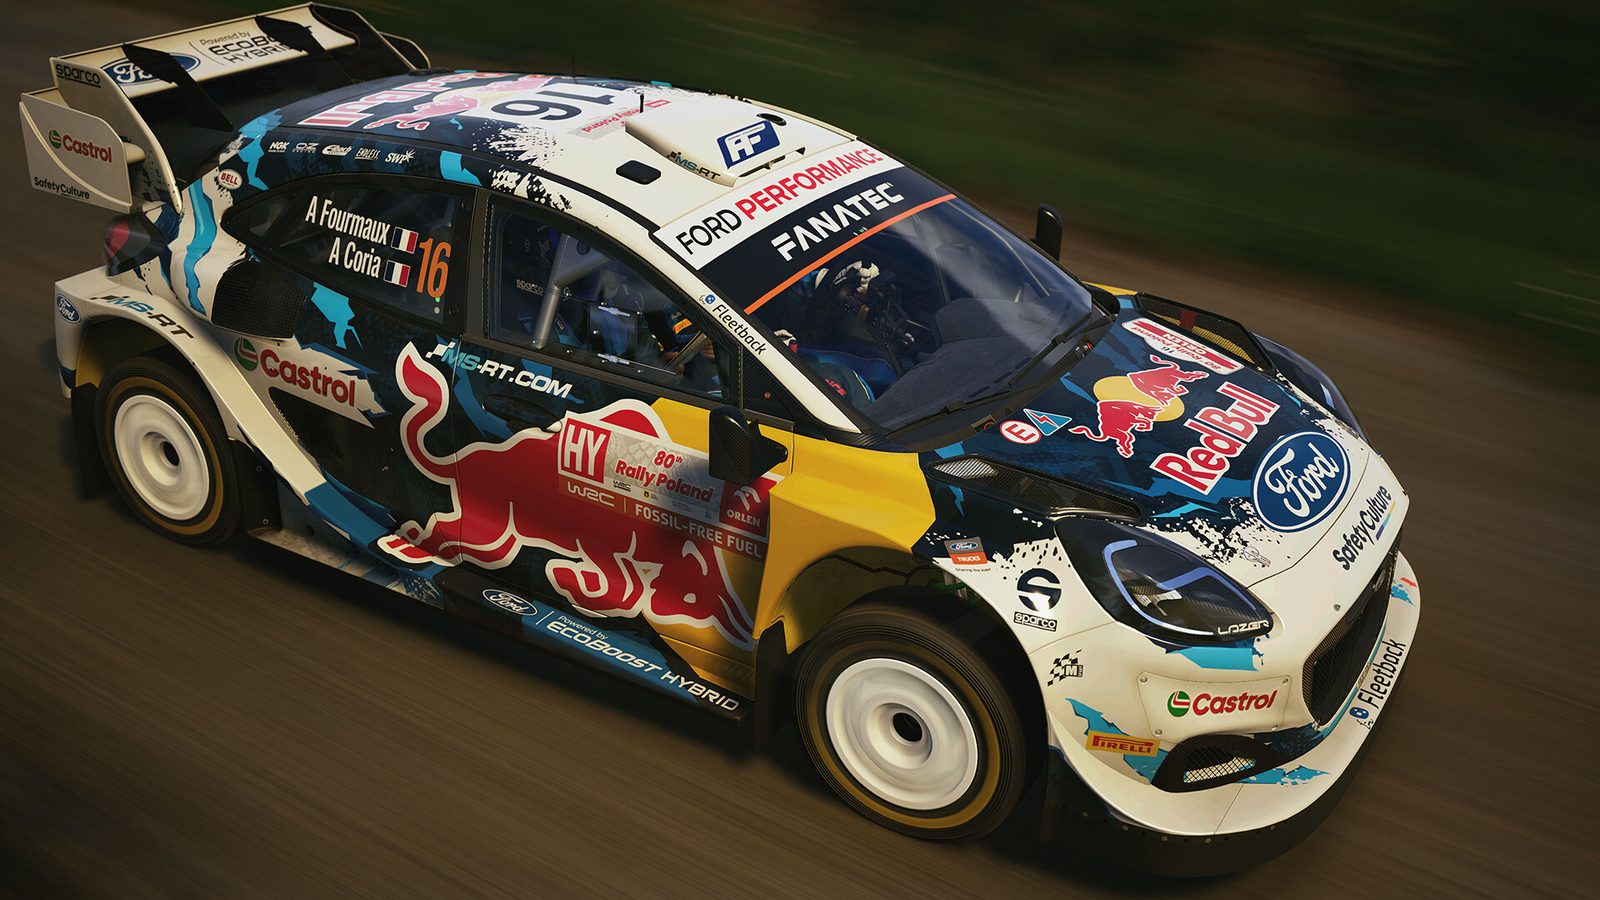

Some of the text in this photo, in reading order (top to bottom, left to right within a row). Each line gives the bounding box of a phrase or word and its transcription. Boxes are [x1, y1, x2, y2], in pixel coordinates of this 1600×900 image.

[200, 31, 251, 46] Powered by
[55, 63, 101, 87] sparco
[490, 90, 616, 121] 16
[62, 134, 112, 163] Castrol
[270, 141, 290, 150] NGK
[296, 142, 319, 152] OZ
[355, 147, 380, 160] ENDLESS
[385, 152, 409, 164] SWP
[34, 176, 90, 200] SafetyCulture
[220, 172, 238, 185] BELL
[675, 147, 884, 255] FORD PERFORMANCE
[304, 195, 391, 246] A Fourmaux
[770, 181, 905, 262] FANATEC
[328, 237, 382, 279] A Coria
[416, 237, 452, 299] 16
[57, 297, 77, 322] Ford
[712, 304, 767, 356] Fleetback
[1162, 334, 1207, 355] ORLEN
[260, 349, 356, 407] Castrol
[1005, 423, 1036, 441] E
[564, 424, 607, 477] HY
[615, 459, 714, 504] Rally Poland
[1264, 442, 1341, 518] Ford
[567, 481, 616, 508] WRC
[726, 508, 761, 528] ORLEN
[1333, 485, 1392, 571] SafetyCulture
[635, 503, 762, 560] FOSSIL-FREE FUEL
[490, 592, 531, 615] Ford
[558, 615, 609, 641] Powered by
[1015, 612, 1057, 630] sparco
[1217, 619, 1270, 636] LAZER
[546, 621, 740, 712] ECOBOOST HYBRID
[1357, 638, 1407, 710] Fleetback
[1192, 690, 1278, 716] Castrol
[1092, 735, 1155, 754] PIRELLI
